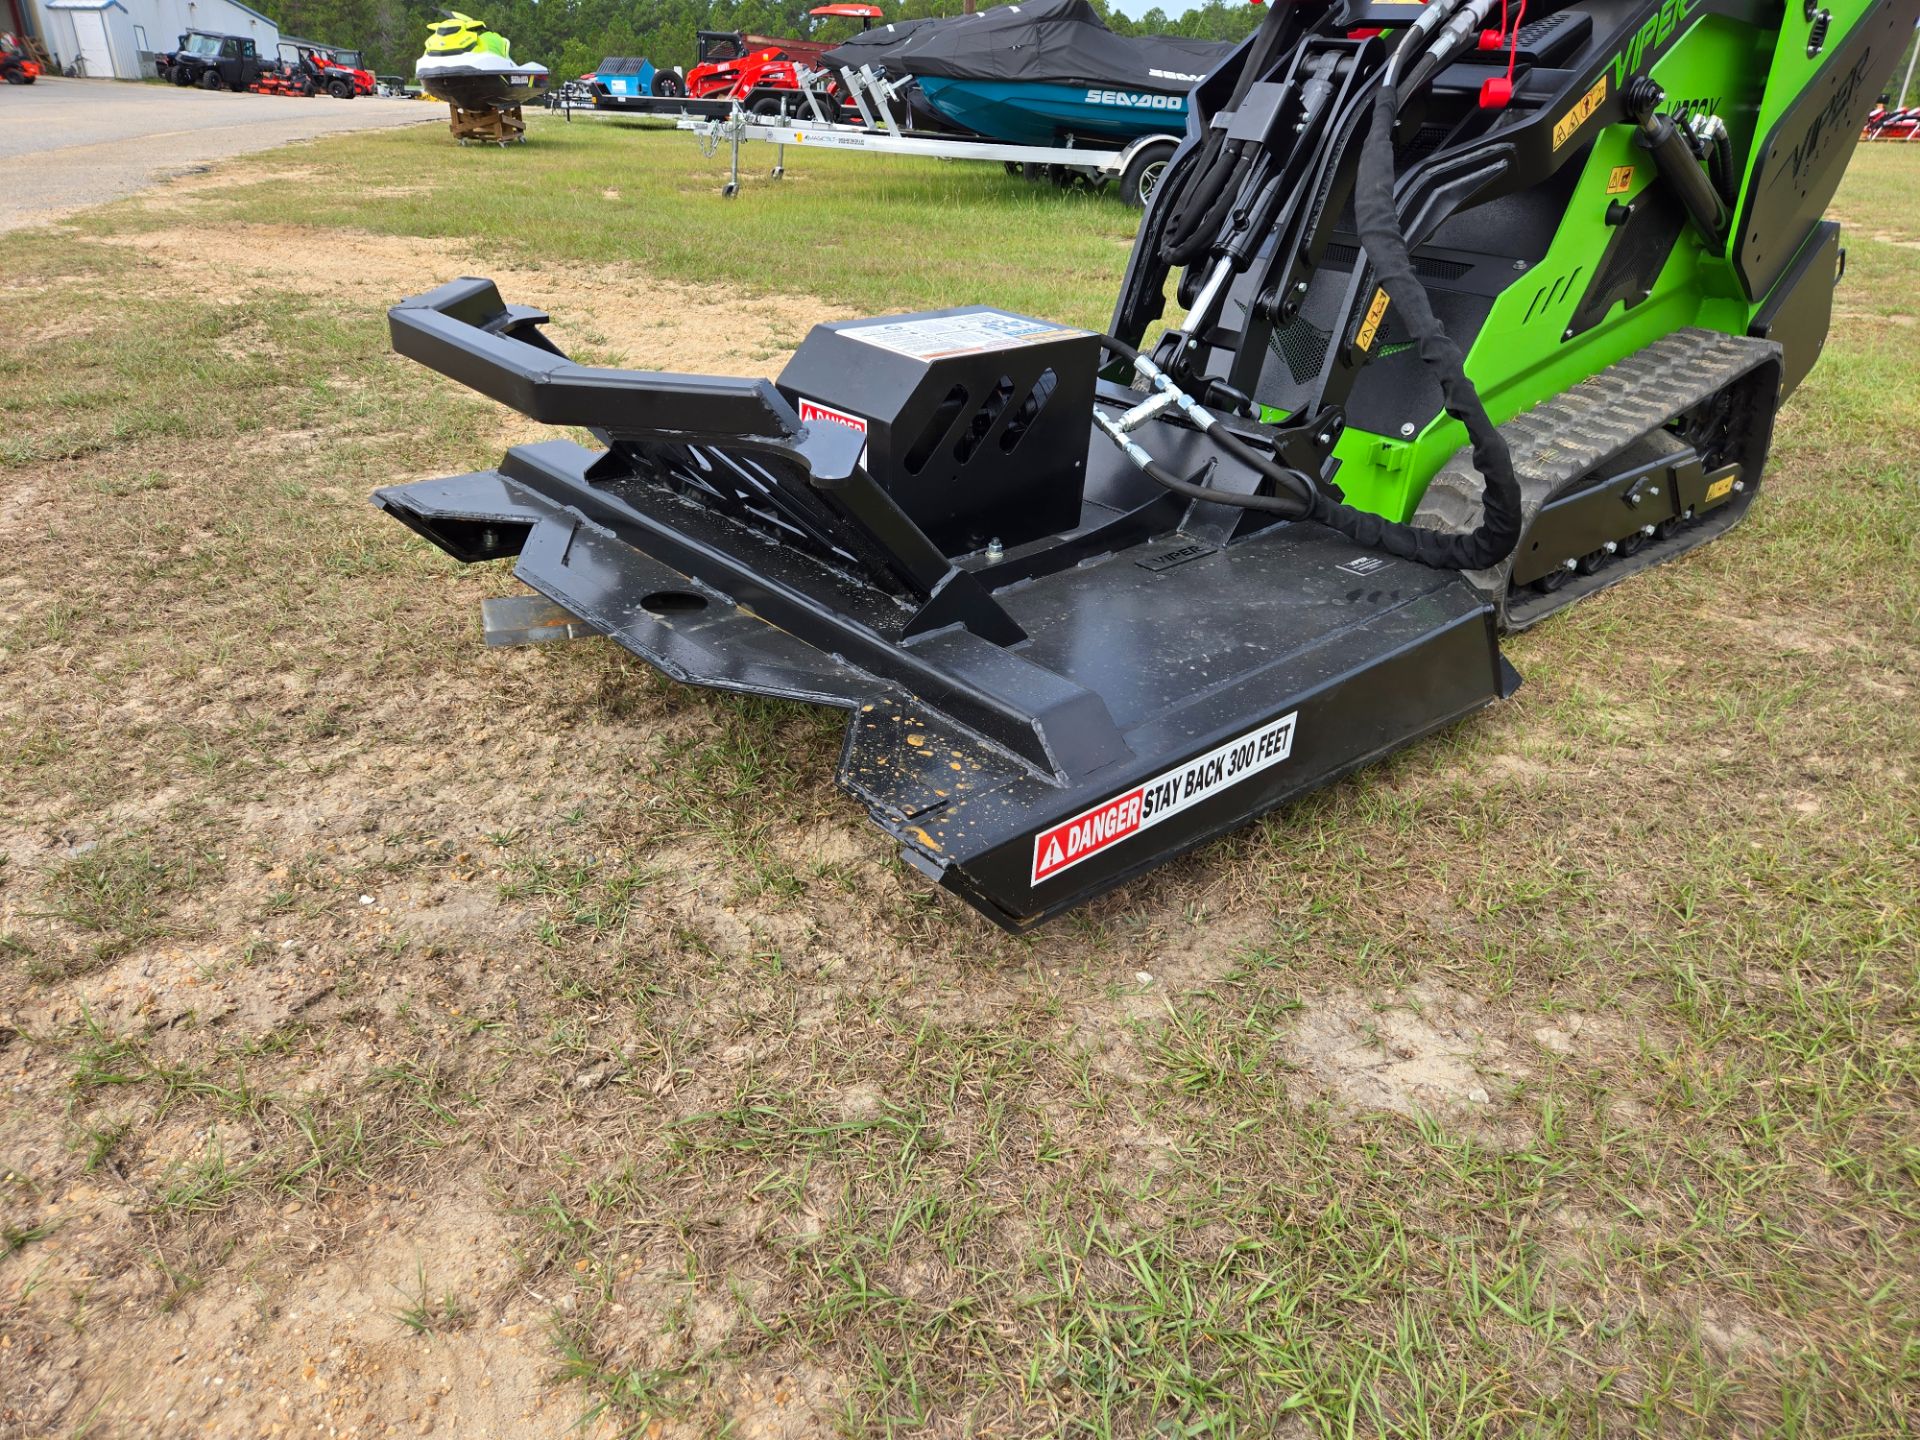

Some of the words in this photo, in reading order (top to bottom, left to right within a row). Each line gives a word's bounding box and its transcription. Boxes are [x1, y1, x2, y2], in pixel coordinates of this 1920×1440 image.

[1153, 545, 1204, 564] VIPER
[1067, 796, 1141, 858] DANGER
[1142, 775, 1184, 818] STAY
[1184, 754, 1226, 798] BACK
[1227, 740, 1256, 776] 300
[1256, 724, 1291, 762] FEET
